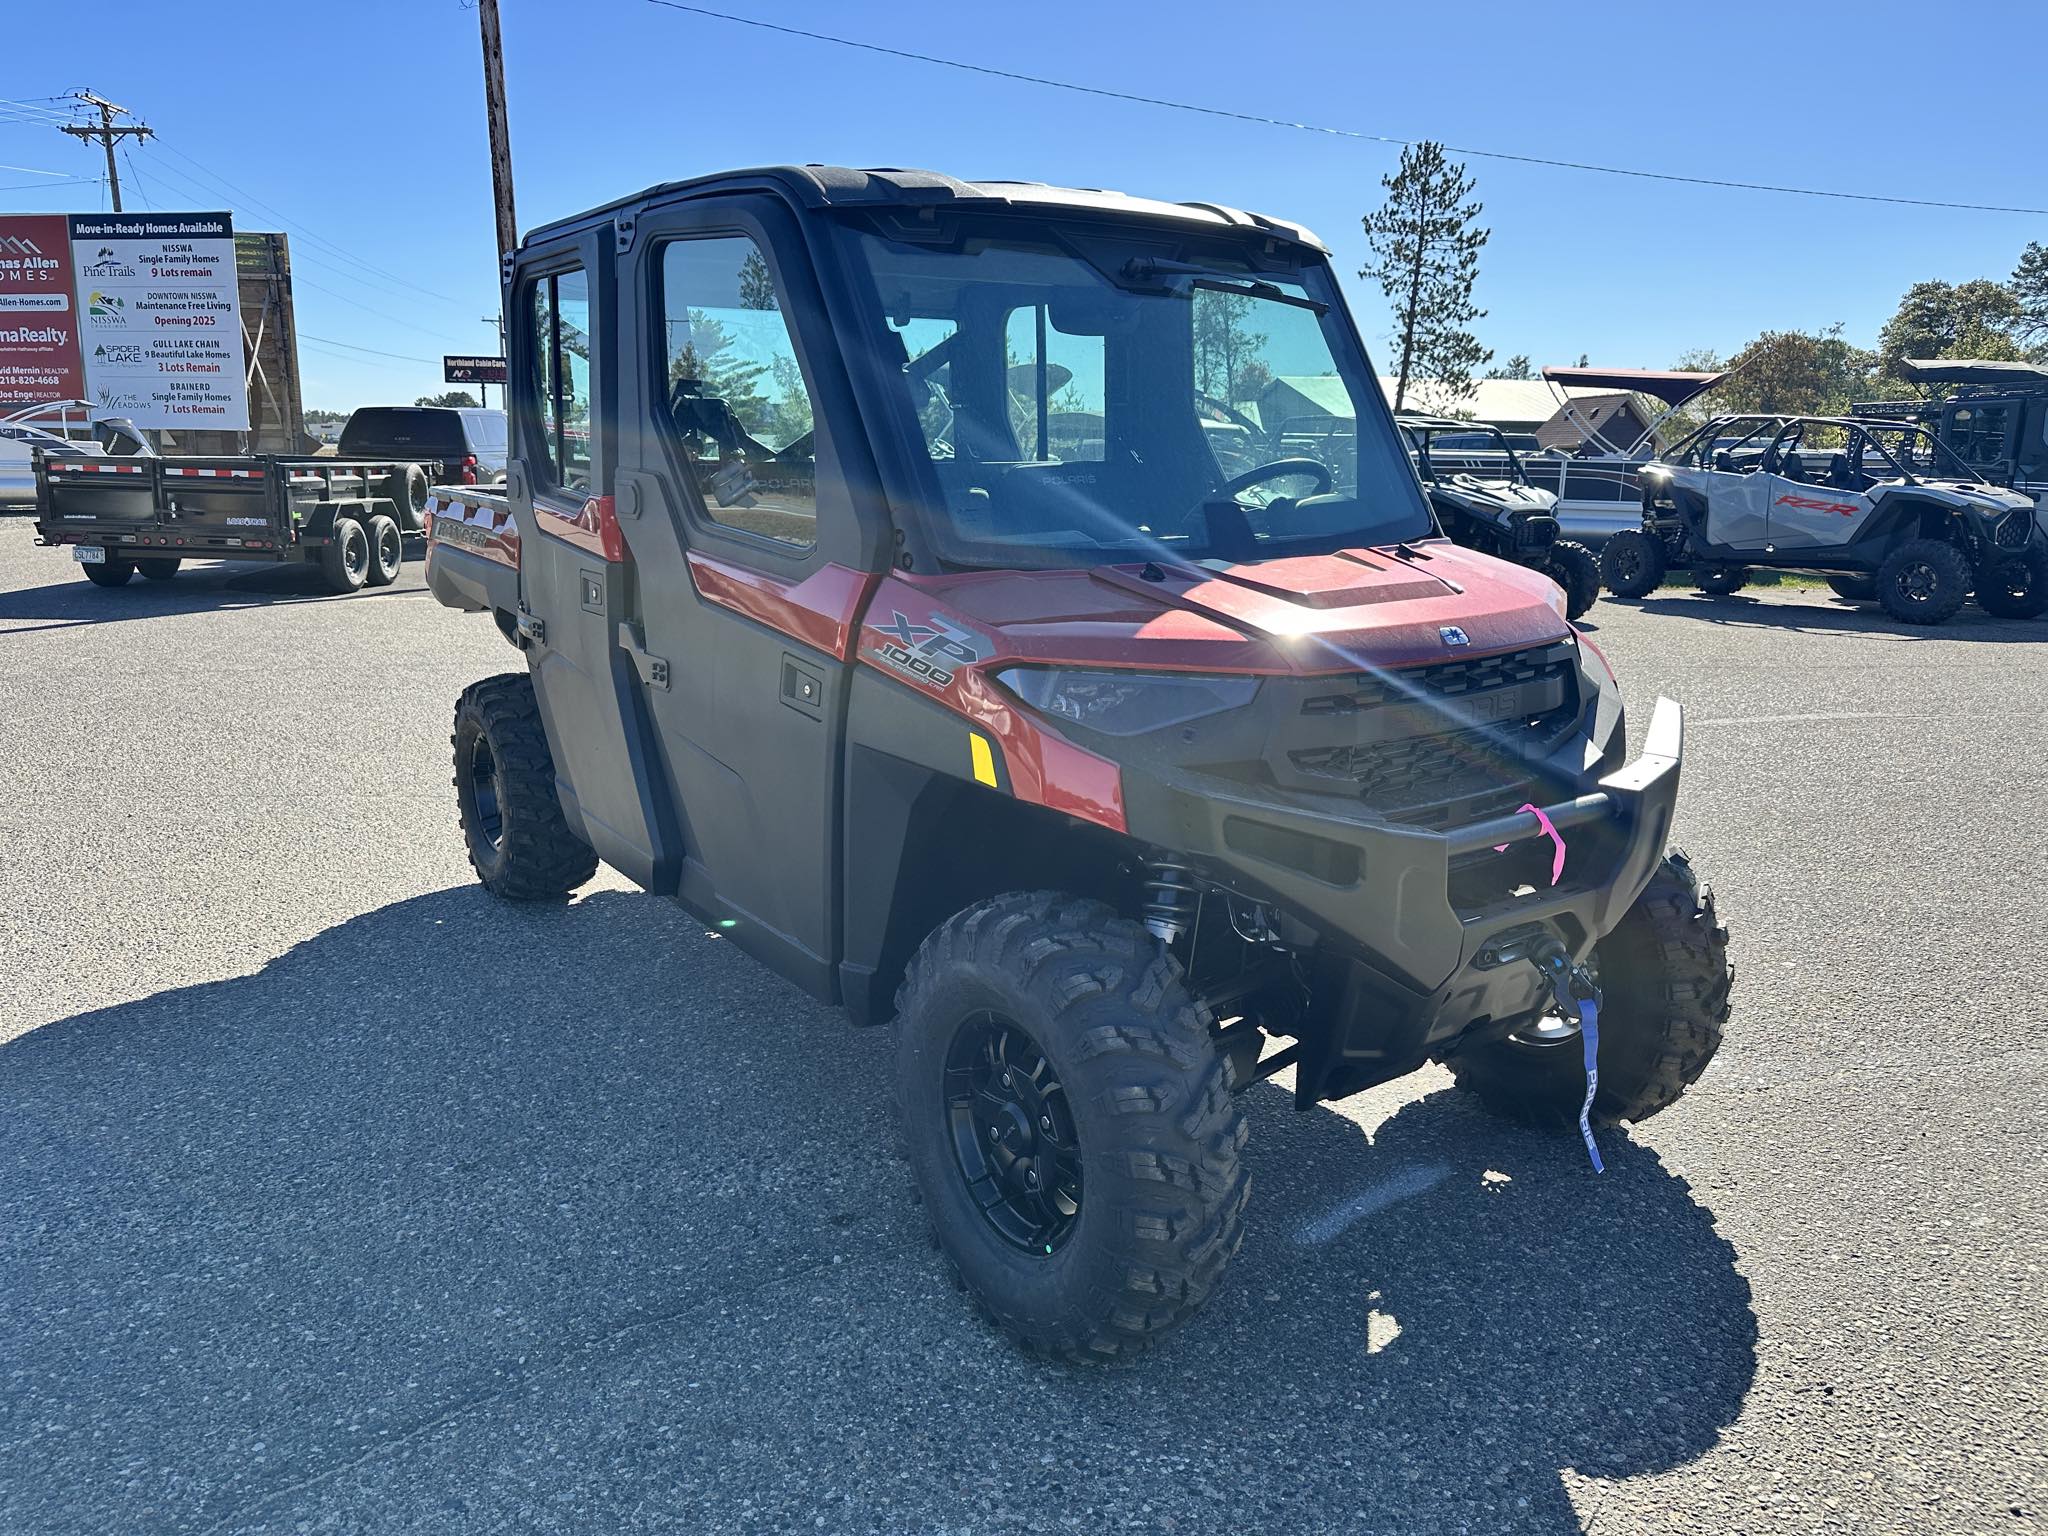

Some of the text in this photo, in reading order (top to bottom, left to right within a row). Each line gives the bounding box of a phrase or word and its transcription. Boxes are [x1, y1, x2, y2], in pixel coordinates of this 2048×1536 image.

[76, 222, 224, 235] Move-in-Ready Homes Available
[162, 244, 193, 253] NISSWA
[23, 257, 59, 269] Allen
[138, 254, 220, 265] Single Family Homes
[83, 265, 136, 277] Pine Trails
[151, 267, 213, 277] 9 Lots remain
[147, 292, 218, 300] DOWNTOWN NISSWA
[136, 301, 232, 312] Maintenance Free Living
[90, 315, 127, 324] NISSWA
[154, 315, 216, 327] Opening 2025
[152, 340, 220, 348] GULL LAKE CHAIN
[107, 353, 143, 363] LAKE
[144, 350, 231, 359] 9 Beautiful Lake Homes
[44, 367, 69, 375] REALTOR
[158, 362, 164, 372] 3
[165, 362, 185, 373] Lots
[186, 362, 221, 373] Remain
[170, 382, 211, 391] BRAINERD
[14, 391, 34, 400] Enge
[152, 392, 232, 403] Single Family Homes
[164, 404, 226, 414] 7 Lots Remain
[1775, 495, 1860, 517] RZR
[435, 521, 487, 549] RANGER
[864, 608, 978, 665] XP
[873, 641, 955, 688] 1000
[1580, 1069, 1598, 1150] POLARIS
